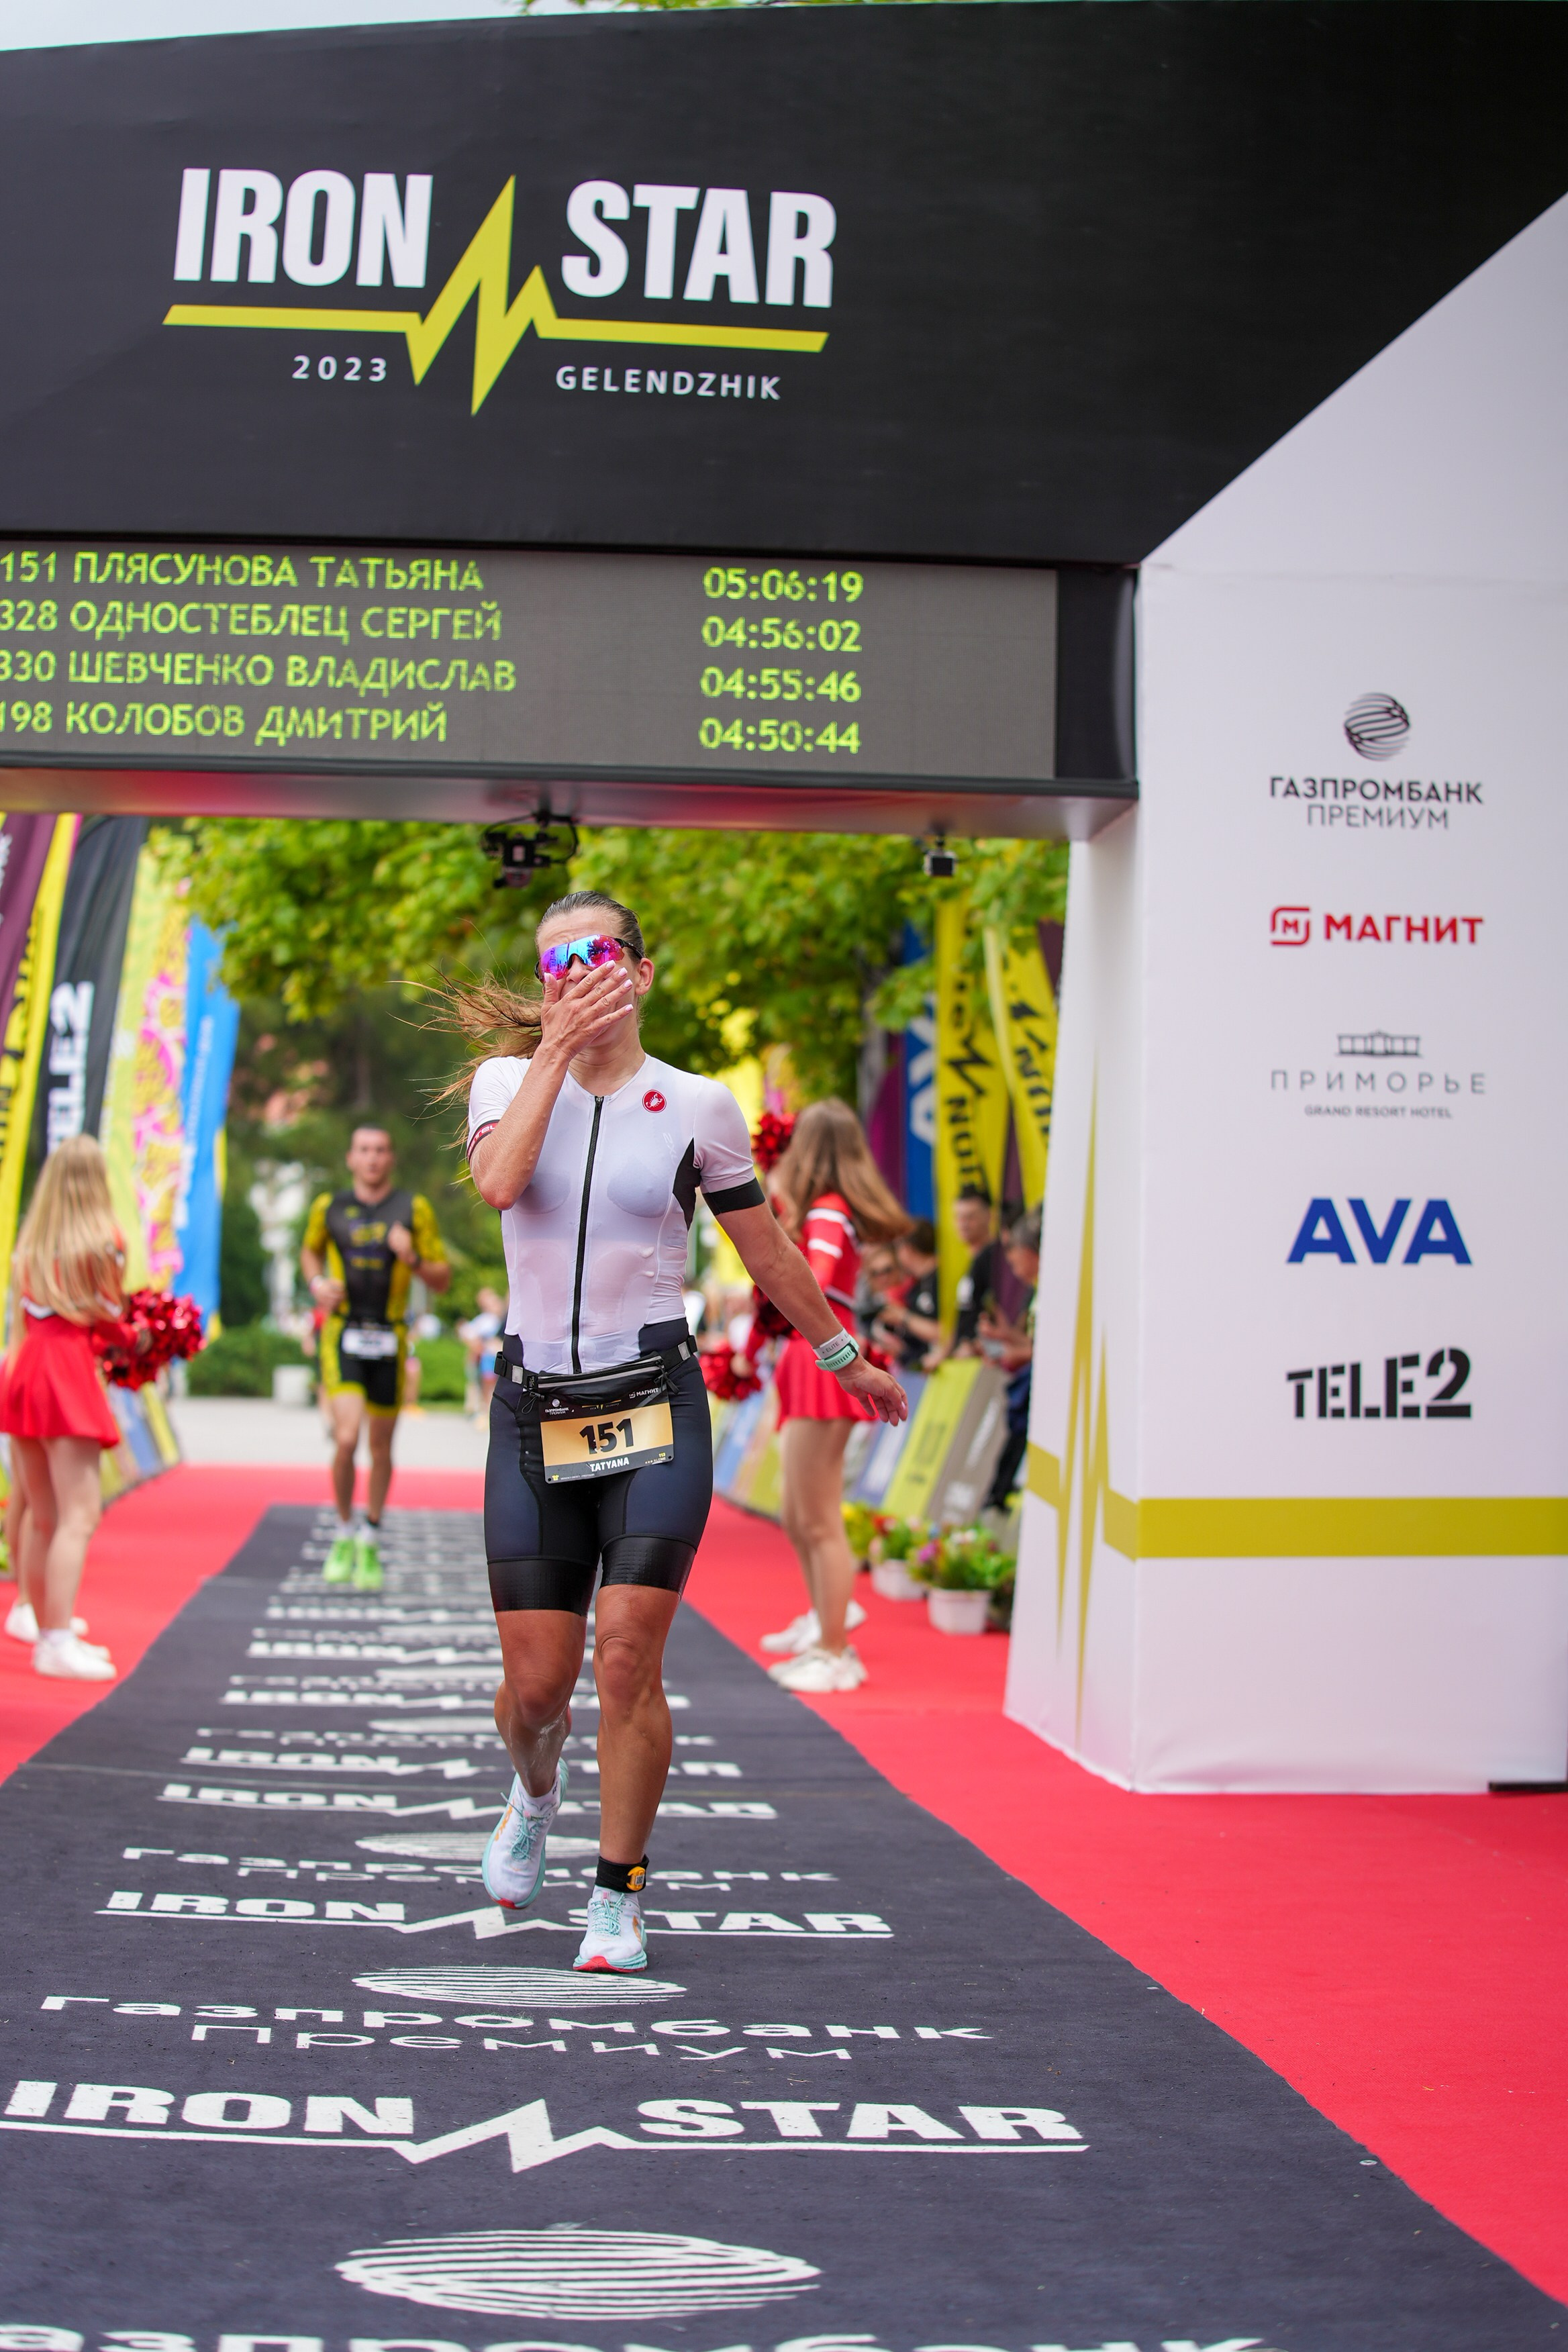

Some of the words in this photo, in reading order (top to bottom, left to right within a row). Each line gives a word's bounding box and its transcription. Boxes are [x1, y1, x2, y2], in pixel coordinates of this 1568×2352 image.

[173, 168, 433, 288] IRON
[561, 180, 836, 308] STAR
[292, 355, 387, 382] 2023
[556, 366, 780, 401] GELENDZHIK
[0, 550, 56, 583] 151
[73, 551, 298, 587] ПЛЯСУНОВА
[309, 555, 484, 591] ТАТЬЯНА
[702, 567, 864, 602] 05:06:19
[0, 599, 58, 632] 328
[69, 599, 350, 644] ОДНОСТЕБЛЕЦ
[360, 601, 502, 640] СЕРГЕЙ
[701, 615, 862, 652] 04:56:02
[68, 650, 275, 686] ШЕВЧЕНКО
[286, 654, 516, 697] ВЛАДИСЛАВ
[699, 665, 862, 703] 04:55:46
[66, 701, 245, 737] КОЛОБОВ
[255, 701, 447, 746] ДМИТРИЙ
[698, 716, 861, 754] 04:50:44
[1270, 776, 1483, 804] ГАЗПРОМБАНК
[1307, 803, 1449, 830] ПРЕМИУМ
[1324, 914, 1483, 944] МАГНИТ
[1271, 1069, 1485, 1095] ПРИМОРЬЕ
[1305, 1105, 1352, 1118] GRAND
[1355, 1106, 1406, 1119] RESORT
[1410, 1106, 1453, 1120] HOTEL
[1287, 1197, 1473, 1265] AVA
[826, 1340, 840, 1353] ELITE
[636, 1387, 659, 1397] МАГНИТ
[1287, 1348, 1471, 1419] TELE2
[579, 1418, 634, 1455] 151
[590, 1456, 630, 1472] TATYANA
[162, 1783, 397, 1808] IRON
[122, 1847, 840, 1882] Газпроанк
[106, 1890, 405, 1922] IRON
[40, 1995, 993, 2041] Газпромбанк
[191, 2023, 852, 2061] Премиум
[4, 2079, 415, 2135] IRON
[638, 2098, 1084, 2141] STAR
